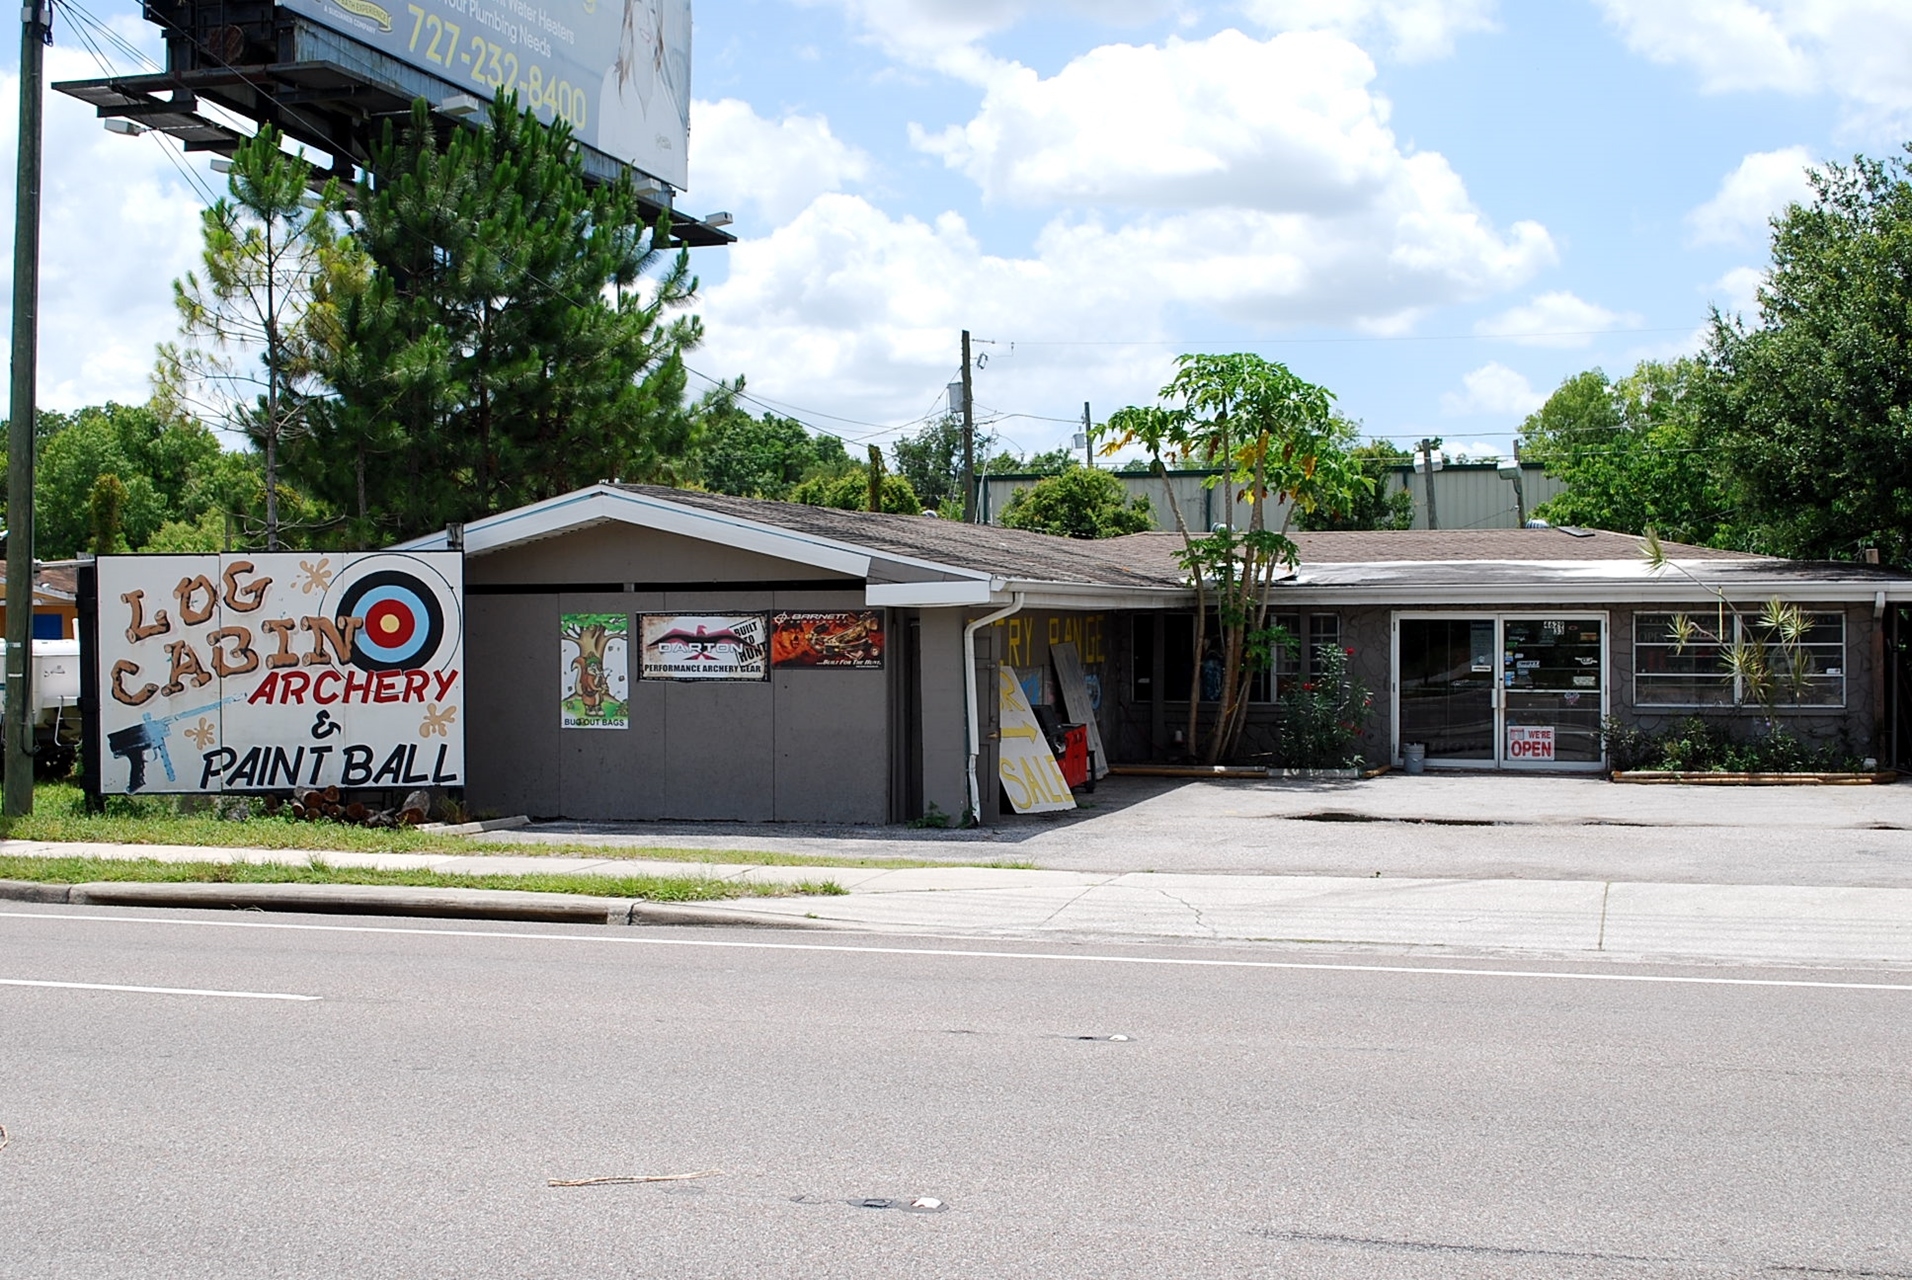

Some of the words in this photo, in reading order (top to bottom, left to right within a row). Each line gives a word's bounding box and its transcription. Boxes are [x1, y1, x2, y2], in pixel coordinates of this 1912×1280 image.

[469, 0, 517, 44] Plumbing
[519, 25, 551, 58] Needs
[509, 0, 537, 23] Water
[538, 11, 575, 45] Heaters
[408, 3, 587, 131] 727-232-8400
[120, 560, 273, 644] LOG
[734, 621, 758, 637] BUILT
[744, 635, 755, 644] TO
[658, 642, 744, 653] DARTON
[739, 642, 766, 663] HUNT
[111, 616, 364, 706] CABIN
[644, 664, 701, 673] PERFORMANCE
[702, 664, 738, 673] ARCHERY
[740, 665, 761, 673] GEAR
[247, 669, 459, 705] ARCHERY
[311, 709, 341, 740] &
[564, 718, 582, 727] BUG
[583, 718, 600, 727] OUT
[602, 719, 625, 727] BAGS
[1528, 730, 1552, 739] WE'RE
[1511, 740, 1552, 757] OPEN
[1000, 755, 1074, 809] SALE
